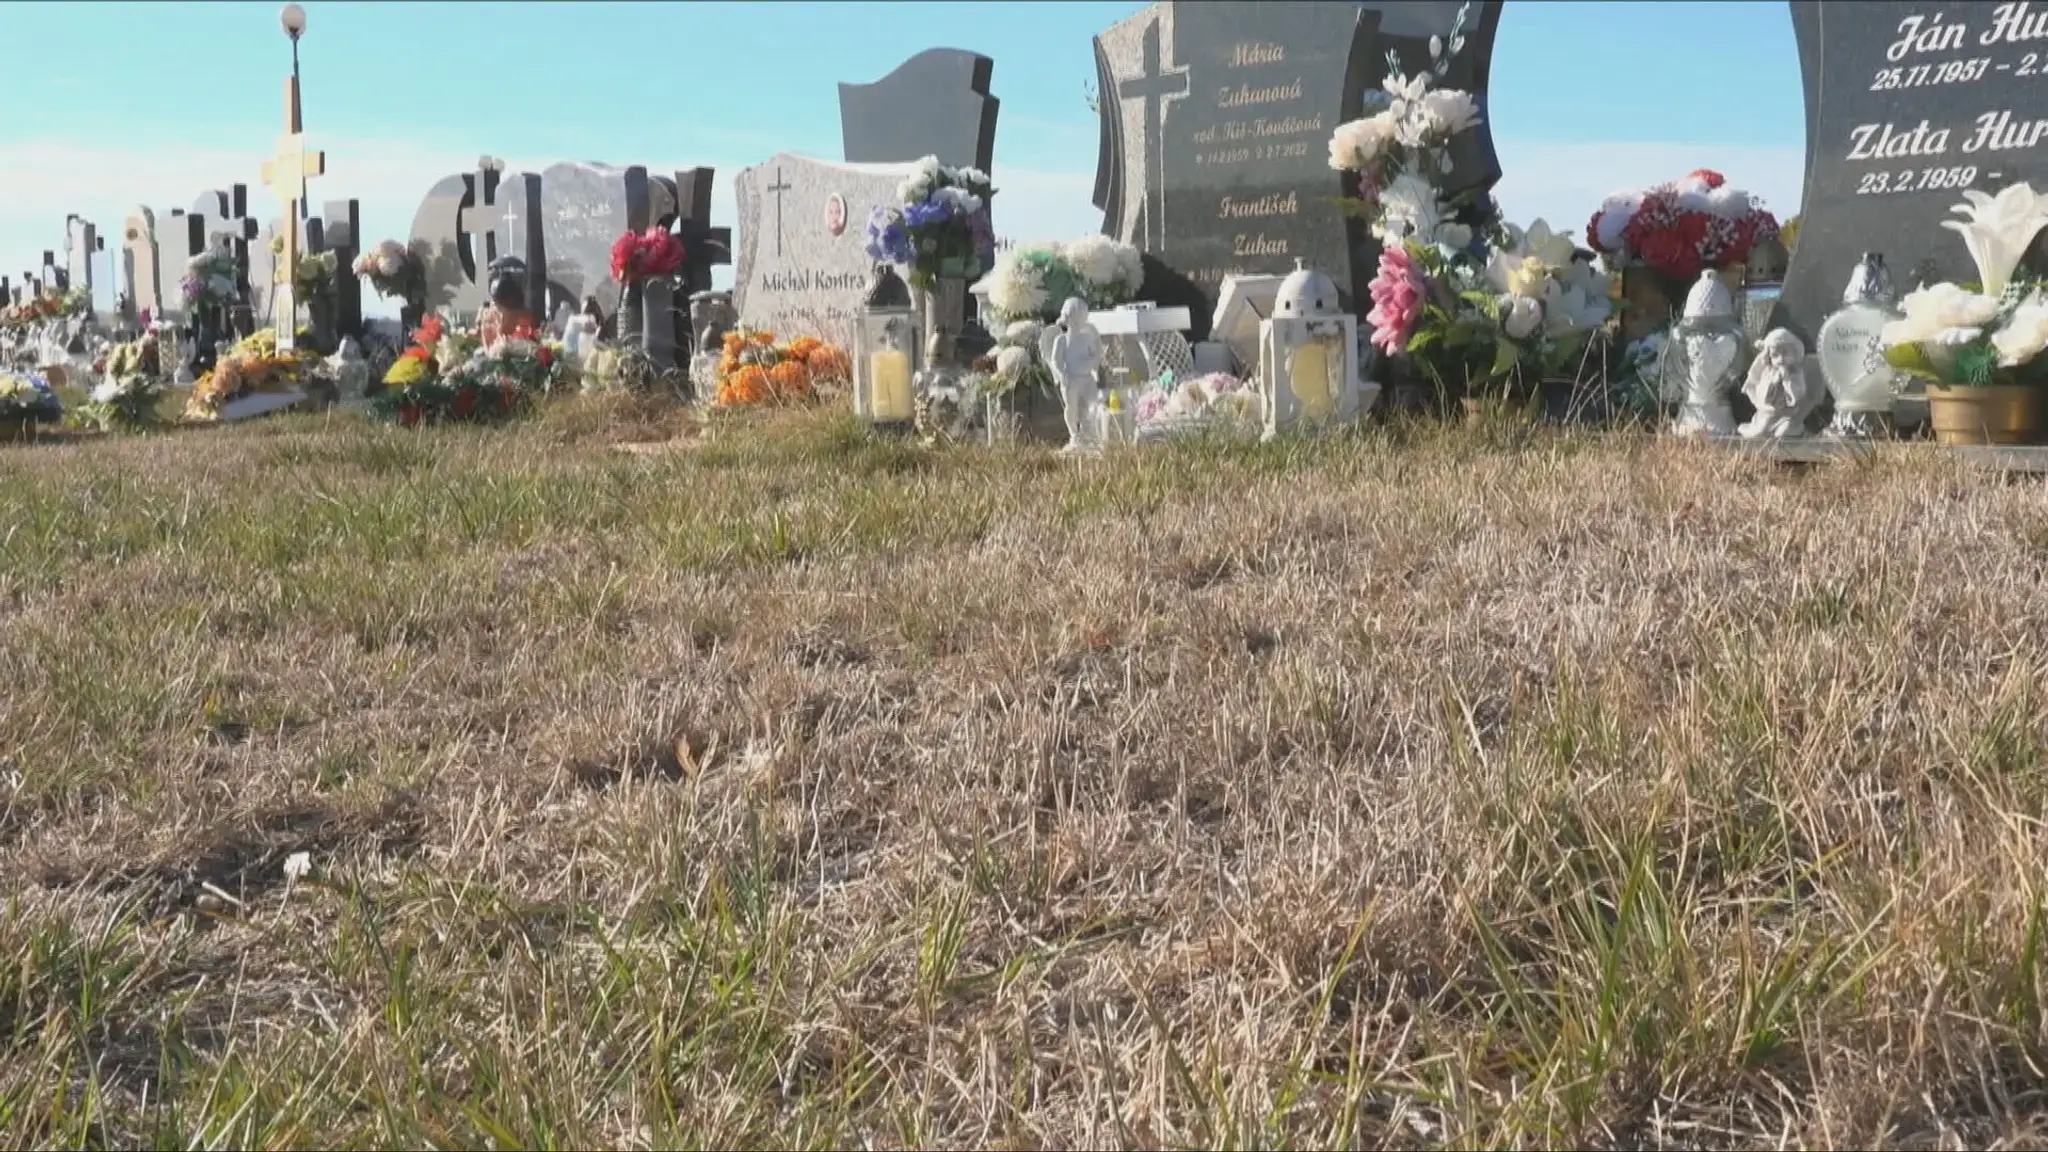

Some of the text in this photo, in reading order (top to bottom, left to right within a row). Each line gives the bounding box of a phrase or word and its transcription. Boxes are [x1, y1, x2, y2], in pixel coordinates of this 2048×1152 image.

[1886, 12, 1966, 62] Ján
[1229, 42, 1284, 68] Mária
[1845, 119, 1951, 161] Zlata
[1856, 165, 1977, 195] 23.2.1959
[1218, 190, 1298, 219] František
[1234, 231, 1289, 257] Zuhan
[762, 267, 810, 292] Michal
